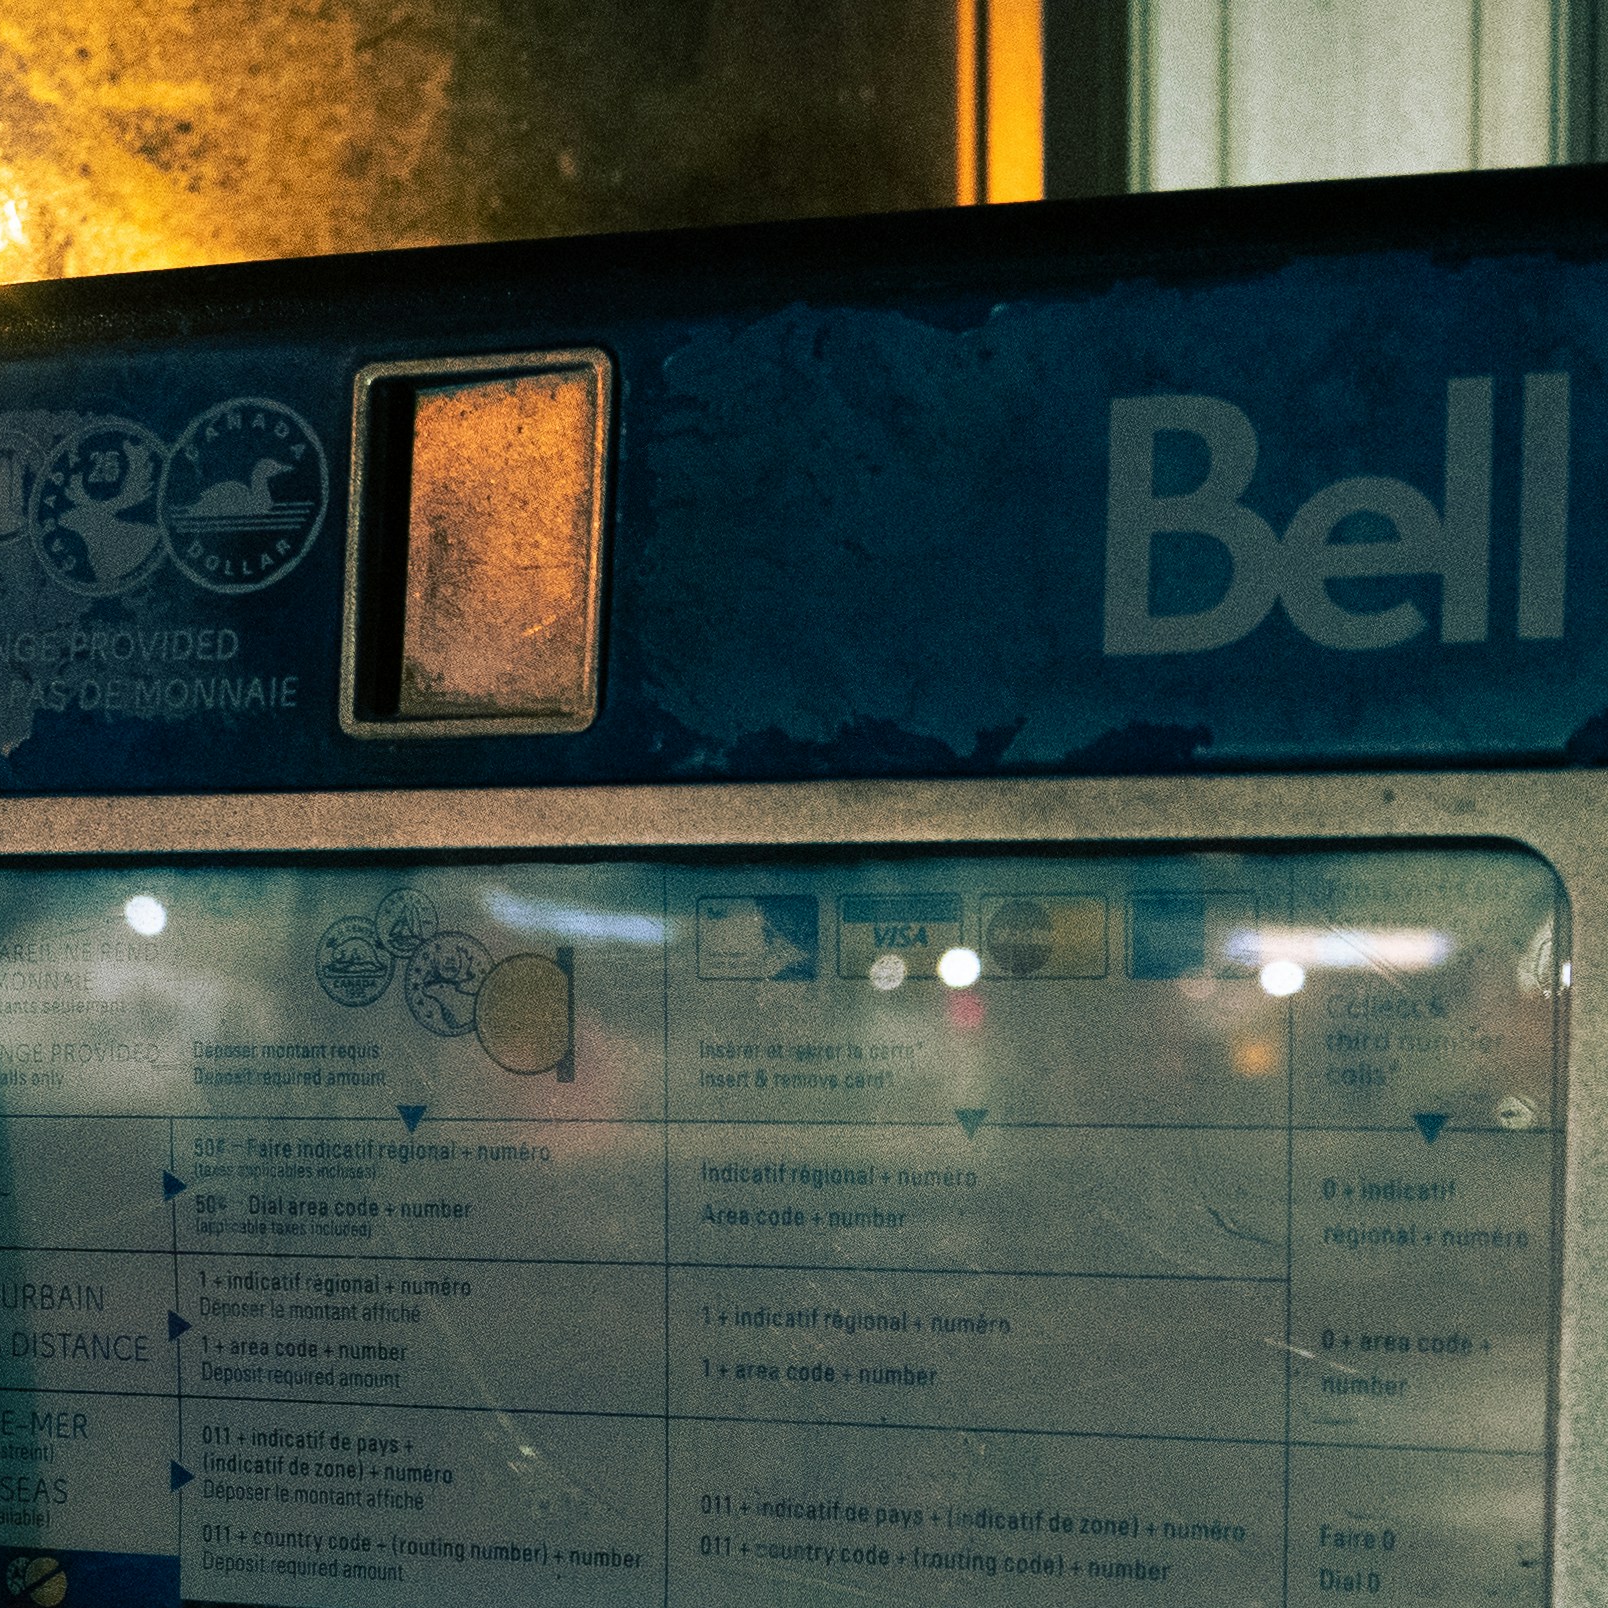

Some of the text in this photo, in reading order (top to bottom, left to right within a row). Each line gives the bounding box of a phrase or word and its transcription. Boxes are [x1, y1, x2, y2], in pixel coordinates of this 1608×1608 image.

[185, 409, 308, 462] CANADA
[1103, 369, 1572, 657] Bell
[186, 537, 292, 577] DOLLAR
[68, 628, 240, 662] PROVIDED
[9, 678, 67, 712] PAS
[79, 677, 122, 710] DE
[135, 674, 298, 709] MONNAIE
[872, 925, 929, 949] VISA
[51, 1043, 160, 1064] PROVIDED
[262, 1042, 381, 1065] montant requis
[194, 1067, 387, 1090] Deposit required amount
[700, 1068, 837, 1090] Insert & remove
[247, 1138, 292, 1159] Faire
[297, 1138, 374, 1160] indicatif
[477, 1143, 551, 1163] numéro
[701, 1161, 977, 1190] Indicatif régional numéro
[1360, 1175, 1455, 1201] indicatif
[248, 1195, 472, 1219] Dial area code number
[701, 1202, 907, 1228] Area code number
[228, 1271, 472, 1297] indicatif régional numéro
[289, 1302, 421, 1323] montant affiché
[734, 1306, 1011, 1335] indicatif régional numéro
[12, 1331, 149, 1362] DISTANCE
[230, 1339, 407, 1361] area code number
[1360, 1330, 1473, 1356] area code
[201, 1361, 401, 1388] Deposit required amount
[734, 1362, 938, 1387] area code number
[1321, 1375, 1408, 1397] number
[203, 1425, 399, 1457] 011 indicatif de pays
[203, 1453, 454, 1485] (indicatif de zone) numéro
[203, 1478, 425, 1511] Déposer le montant affiché
[700, 1494, 1246, 1543] 011 indicatif de pays (indicatif de zone) numéro
[202, 1523, 644, 1568] 011 country code (routing number) number
[1319, 1523, 1397, 1551] Faire 0
[202, 1551, 404, 1582] Deposit required amount
[700, 1534, 1171, 1582] 011 country code (routing code) number
[1319, 1567, 1362, 1593] Dial
